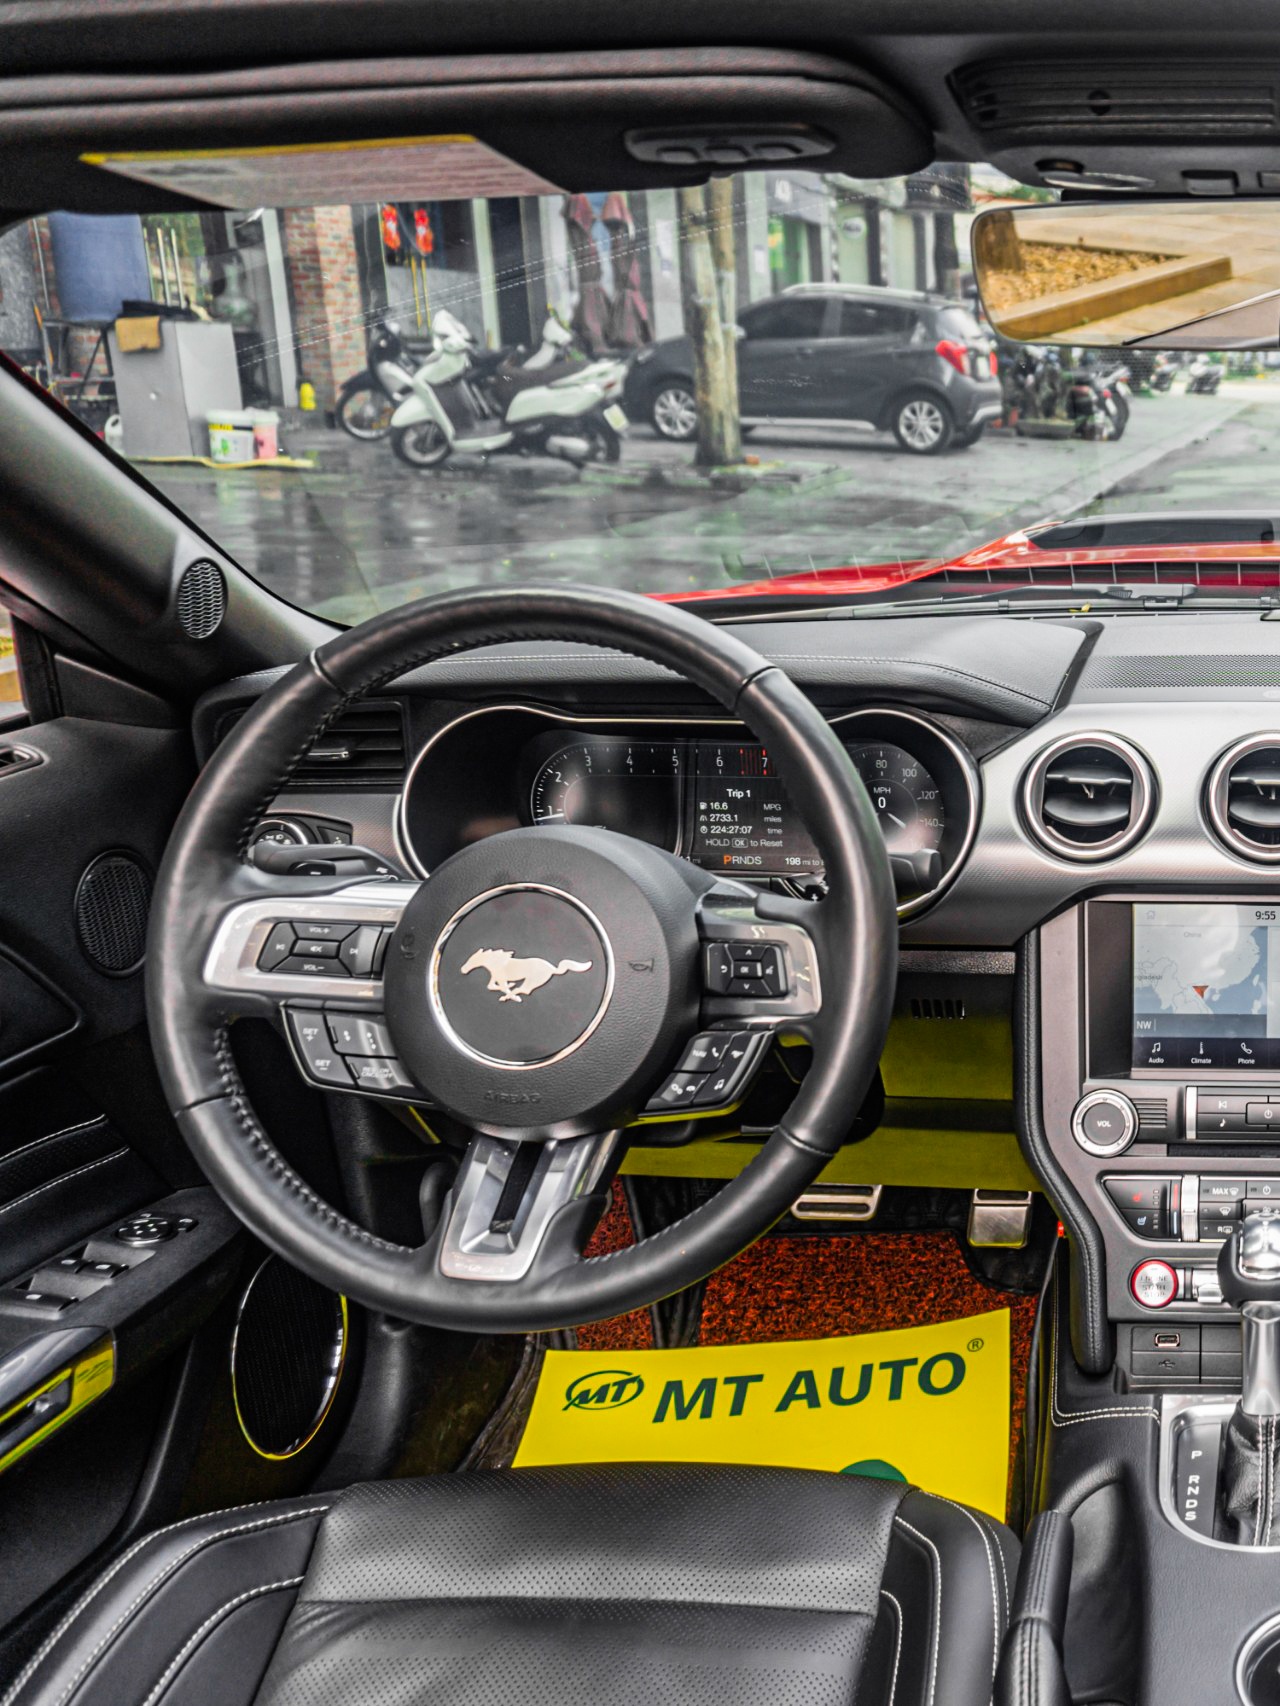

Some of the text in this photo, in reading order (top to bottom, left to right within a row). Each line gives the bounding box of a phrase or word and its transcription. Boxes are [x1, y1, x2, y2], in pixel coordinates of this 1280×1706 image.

[585, 755, 592, 767] 3
[626, 755, 633, 766] 4
[672, 755, 679, 766] 5
[716, 756, 723, 767] 6
[762, 757, 768, 767] 7
[875, 759, 888, 769] 80
[555, 772, 562, 783] 2
[902, 768, 917, 778] 100
[726, 788, 751, 799] Trip 1
[873, 786, 891, 794] MPH
[921, 790, 935, 800] 120
[710, 802, 782, 812] 16.6 MPG
[878, 796, 886, 809] 0
[709, 813, 782, 823] 2733.1 miles
[924, 818, 939, 827] 140
[710, 825, 783, 835] 224:27:07 time
[705, 839, 783, 848] HOLD OK to Reset
[784, 857, 801, 866] 198
[1255, 910, 1276, 921] 9:55
[1136, 1020, 1152, 1030] NW
[1148, 1057, 1165, 1065] Audio
[1190, 1057, 1212, 1065] Climate
[1237, 1057, 1256, 1065] Phone
[1096, 1119, 1112, 1128] VOL
[1212, 1187, 1229, 1195] MAX
[652, 1374, 765, 1424] MT
